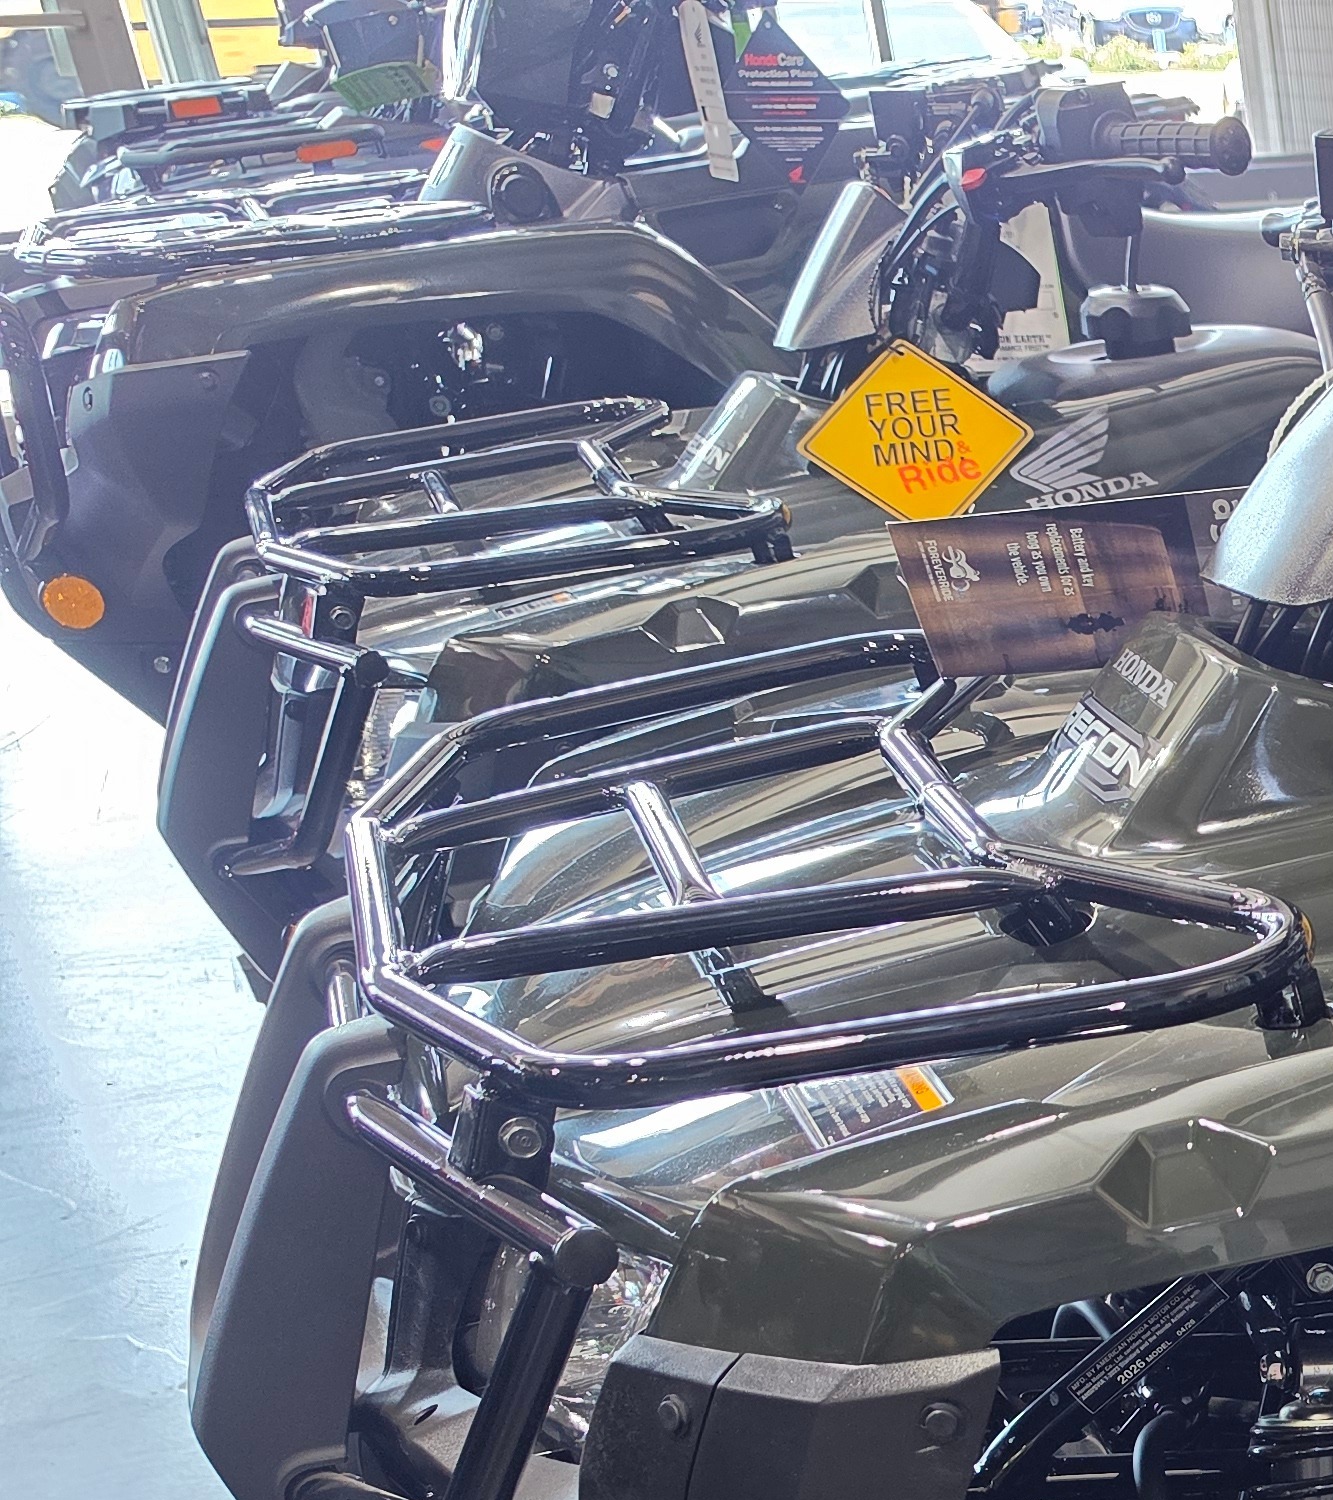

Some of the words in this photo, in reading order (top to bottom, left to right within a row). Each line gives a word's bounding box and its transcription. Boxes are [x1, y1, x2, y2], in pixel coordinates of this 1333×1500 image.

[865, 388, 954, 418] FREE
[868, 413, 962, 441] YOUR
[956, 440, 972, 455] &
[898, 455, 982, 494] Ride
[1026, 470, 1158, 509] HONDA
[1006, 542, 1020, 557] the
[1026, 531, 1040, 550] long
[1046, 523, 1070, 575] replacements
[1070, 528, 1087, 558] Battery
[1032, 560, 1045, 577] you
[1077, 557, 1092, 574] and
[1081, 573, 1095, 588] key
[1038, 576, 1052, 593] own
[1112, 648, 1177, 711] HONDA
[1063, 702, 1152, 788] RECON
[1096, 1341, 1128, 1370] AMERICAN
[1126, 1323, 1149, 1343] HONDA
[1148, 1304, 1170, 1324] MOTOR
[1117, 1359, 1146, 1385] 2026
[1145, 1340, 1172, 1362] MODEL
